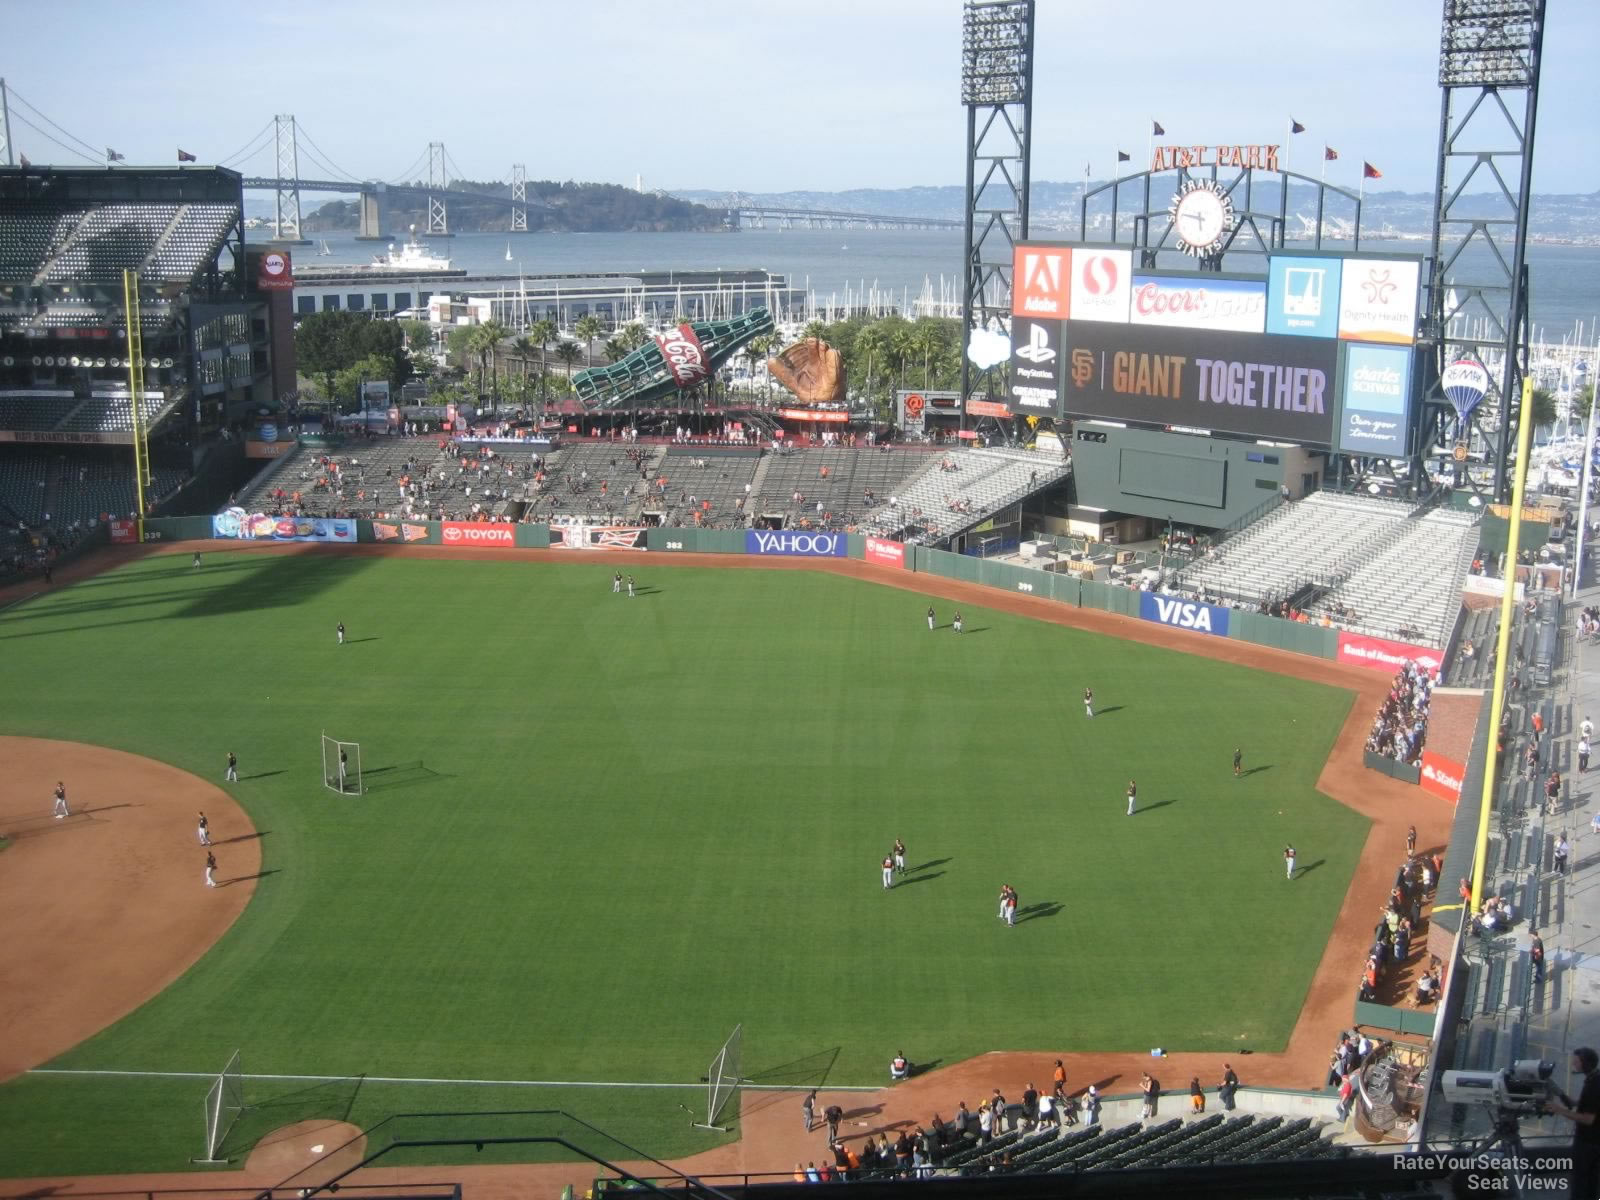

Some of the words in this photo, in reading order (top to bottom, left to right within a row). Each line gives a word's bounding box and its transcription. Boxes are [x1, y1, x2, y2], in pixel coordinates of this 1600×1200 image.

[1151, 145, 1207, 173] AT&T
[1215, 144, 1280, 173] PARK
[1166, 192, 1182, 223] SAN
[1180, 178, 1235, 224] FRANCISCO
[1175, 239, 1222, 258] GIANTS
[1024, 296, 1058, 312] Adobe
[1135, 282, 1206, 317] Coors
[1199, 293, 1265, 319] LIGHT
[1344, 310, 1377, 323] Dignity
[1378, 311, 1409, 323] Health
[1112, 351, 1186, 399] GIANT
[1195, 358, 1326, 414] TOGETHER
[1353, 365, 1401, 383] charles
[1352, 381, 1401, 396] SCHWAB
[144, 532, 161, 540] 339
[463, 528, 513, 541] TOYOTA
[755, 532, 838, 555] YAHOO!
[1153, 596, 1212, 632] VISA
[1343, 643, 1366, 658] Bank
[1366, 649, 1377, 660] of
[1437, 770, 1459, 791] State
